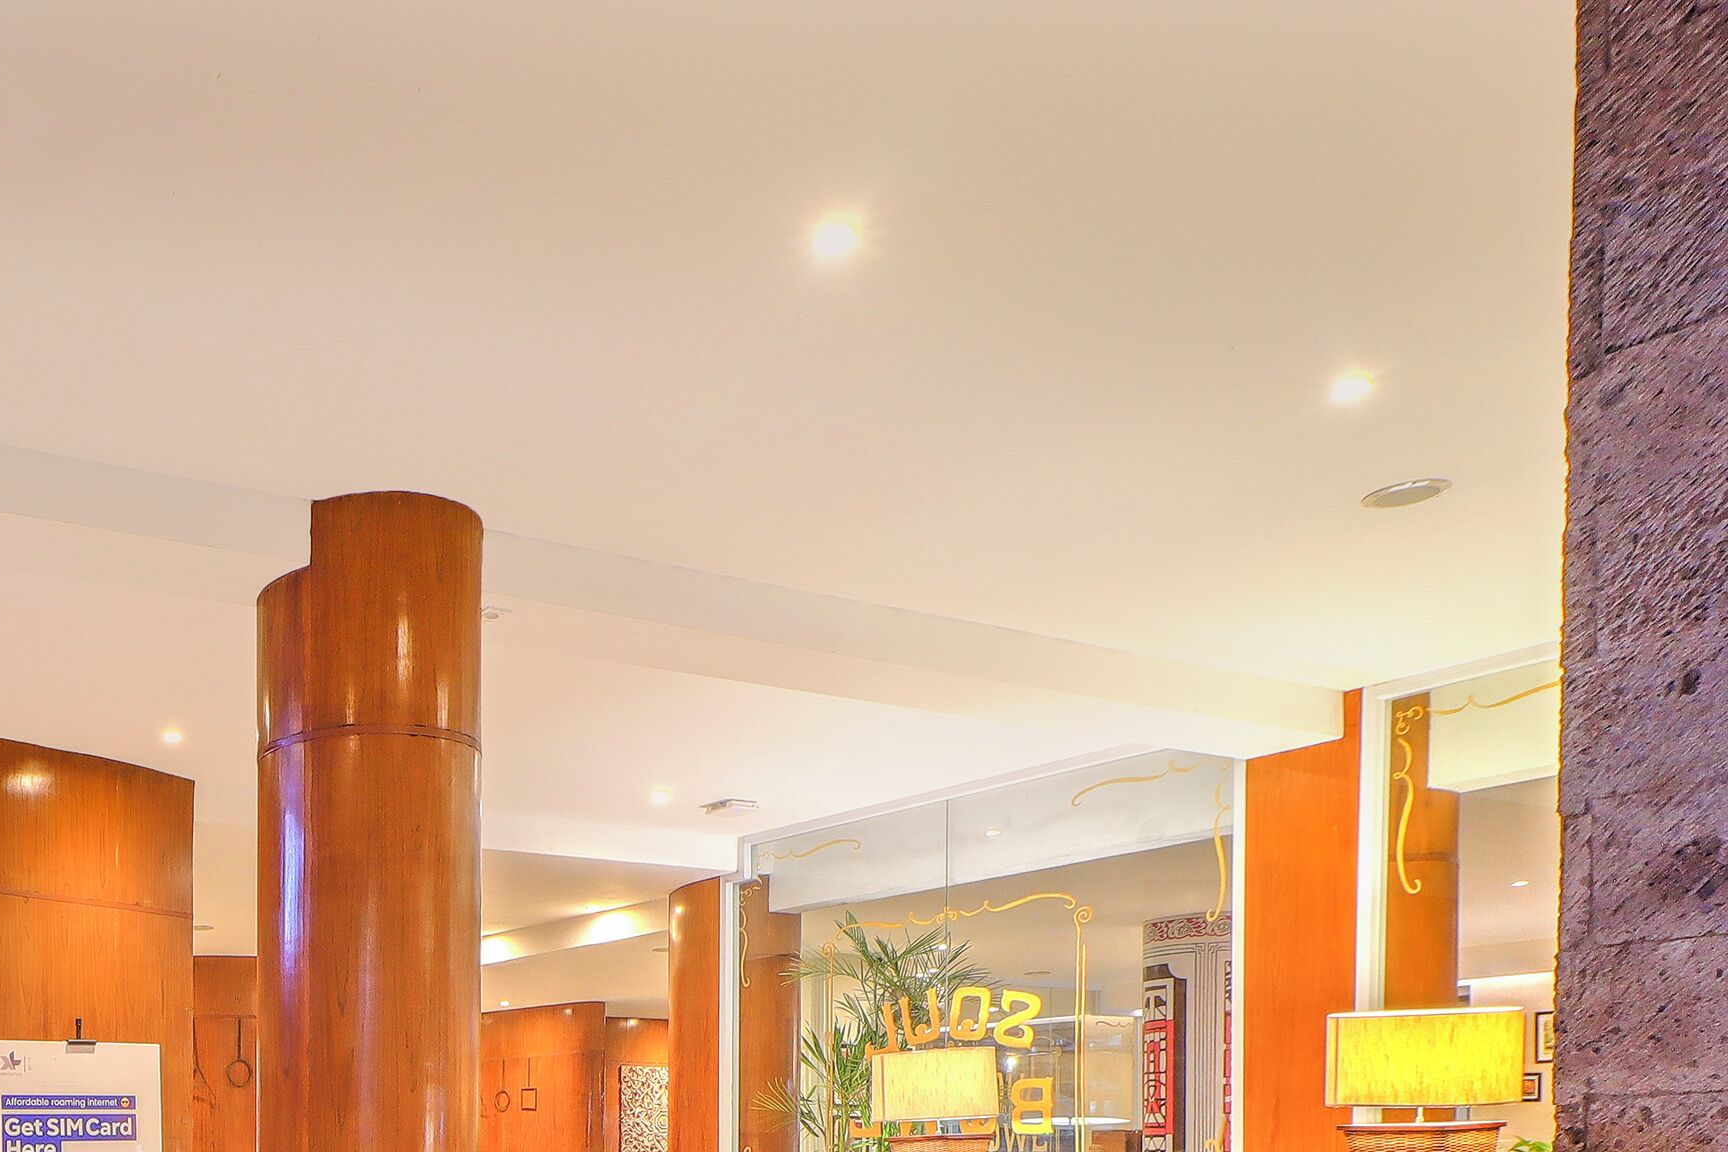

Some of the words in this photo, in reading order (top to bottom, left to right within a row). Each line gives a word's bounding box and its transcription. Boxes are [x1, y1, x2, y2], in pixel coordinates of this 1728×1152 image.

[5, 1096, 50, 1107] Affordable
[50, 1097, 86, 1109] roaming
[4, 1117, 44, 1137] Get
[46, 1117, 83, 1136] SIM
[85, 1117, 132, 1136] Card
